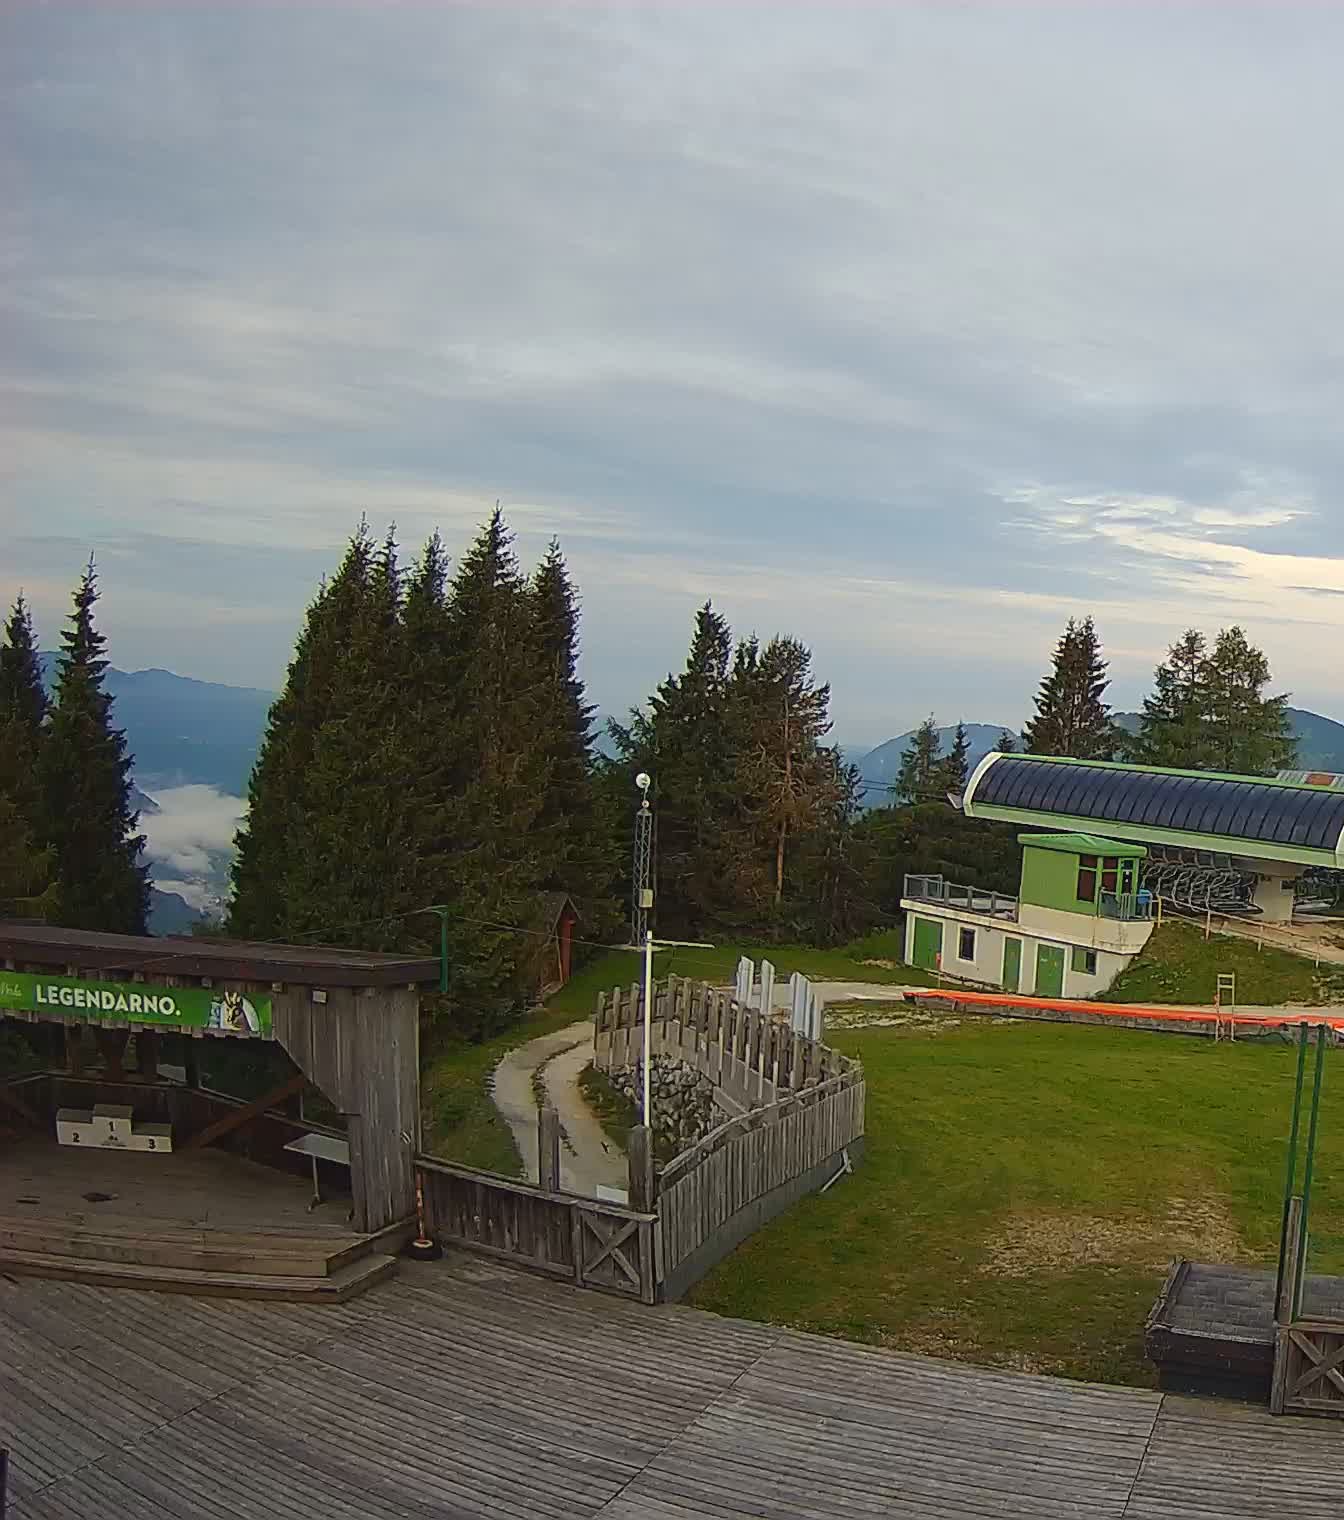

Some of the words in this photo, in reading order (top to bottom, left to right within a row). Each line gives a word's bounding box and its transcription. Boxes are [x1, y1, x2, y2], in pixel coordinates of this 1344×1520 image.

[35, 984, 182, 1017] LEGENDARNO.
[108, 1121, 115, 1132] 1
[72, 1132, 80, 1143] 2
[148, 1138, 156, 1149] 3
